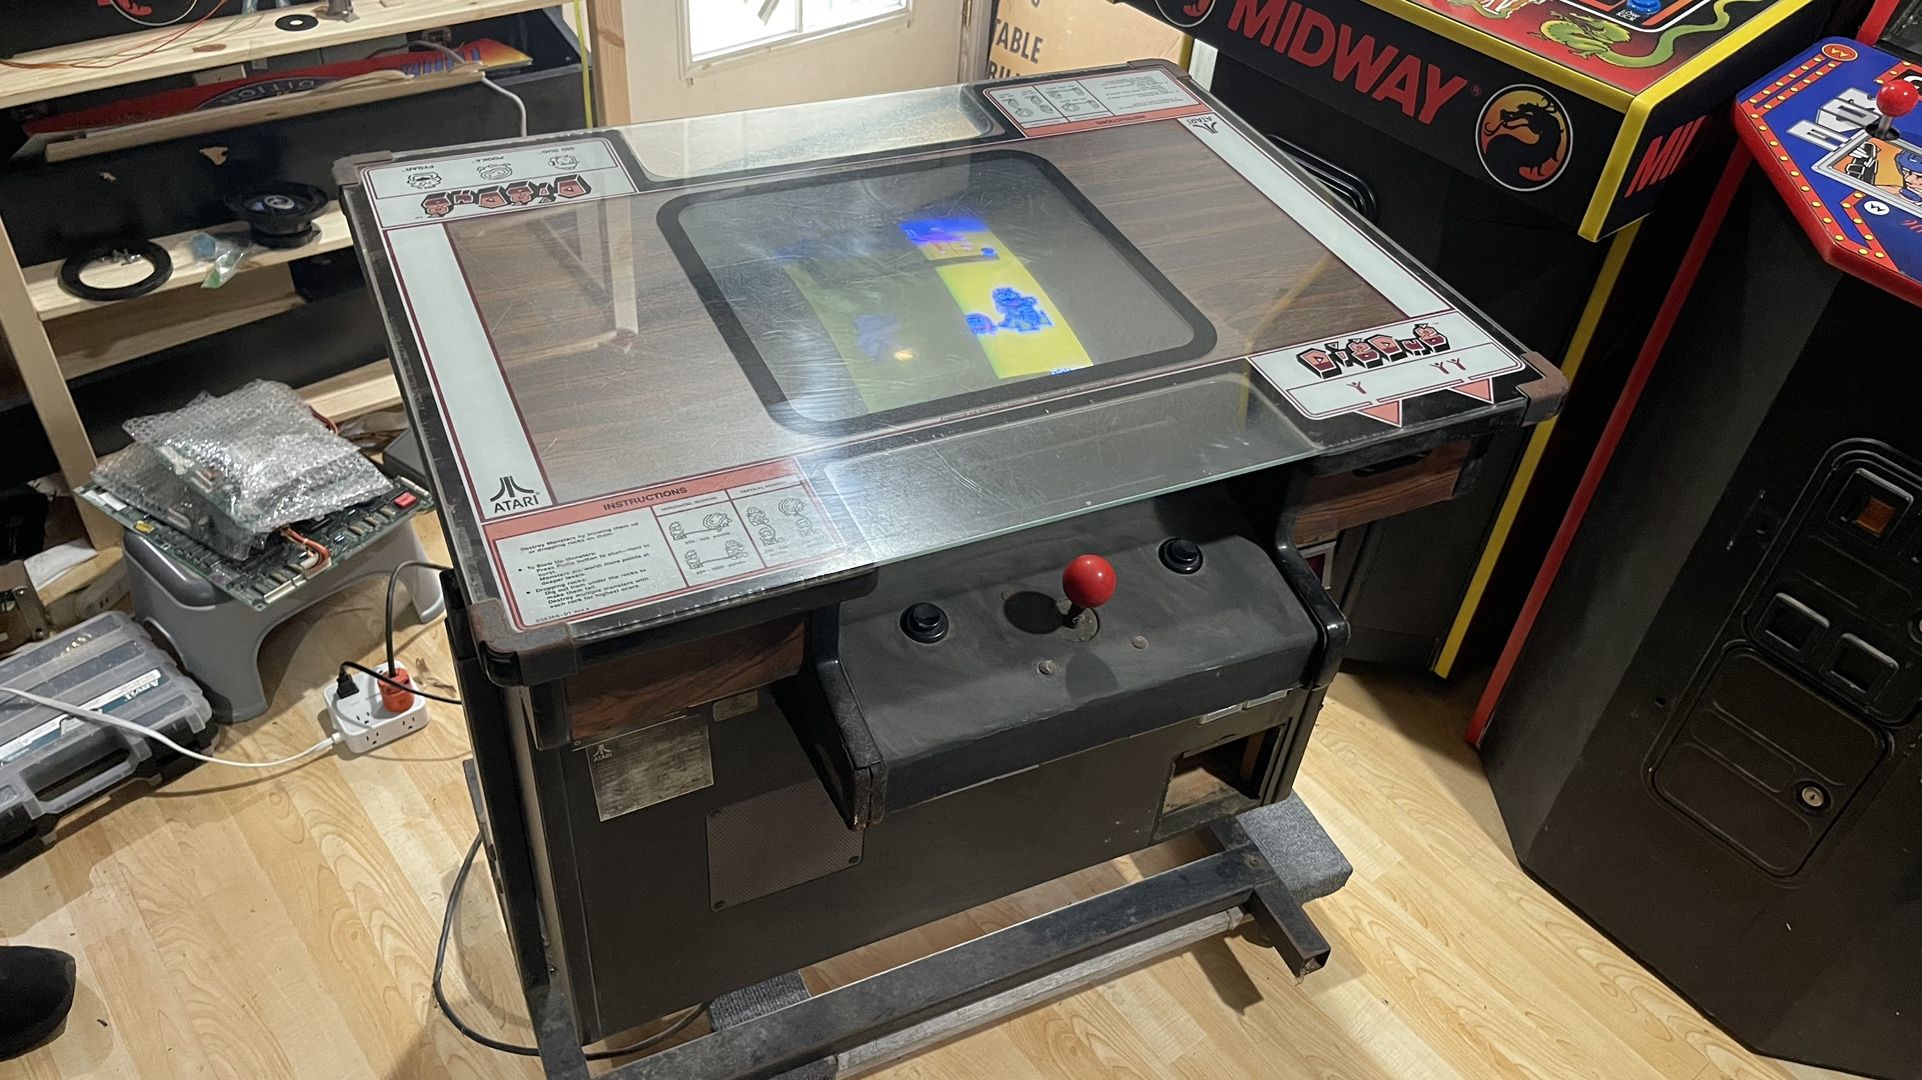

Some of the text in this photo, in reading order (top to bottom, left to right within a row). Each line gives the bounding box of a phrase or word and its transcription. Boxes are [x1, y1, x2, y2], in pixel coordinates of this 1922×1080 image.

[1227, 0, 1469, 125] MIDWAY
[494, 494, 539, 513] ATARI
[602, 486, 689, 512] INSTRUCTIONS
